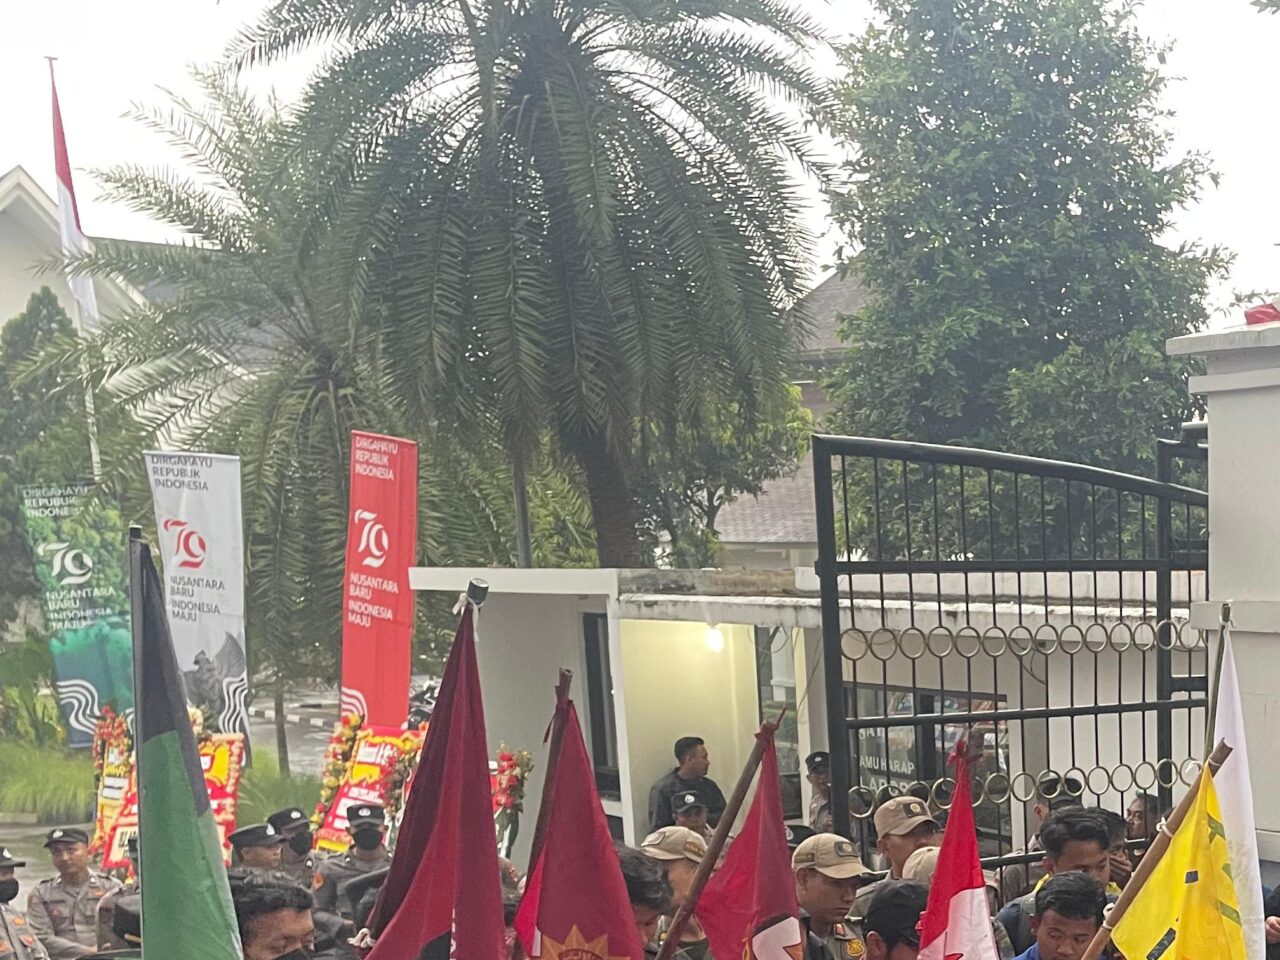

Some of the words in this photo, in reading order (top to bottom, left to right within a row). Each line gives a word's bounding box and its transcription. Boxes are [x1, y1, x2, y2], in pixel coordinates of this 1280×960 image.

[355, 436, 398, 454] DIRGAHAYU
[151, 455, 213, 468] DIRGAHAYU
[355, 450, 389, 466] REPUBLIK
[153, 468, 200, 479] REPUBLIK
[355, 463, 394, 480] INDONESIA
[23, 486, 88, 498] DIRGAHAYU
[154, 479, 209, 491] INDONESIA
[170, 576, 225, 590] NUSANTARA
[350, 572, 399, 593] NUSANTARA
[46, 586, 116, 601] NUSANTARA
[170, 586, 195, 598] BARU
[349, 584, 372, 600] BARU
[48, 599, 80, 610] BARU
[171, 599, 220, 614] INDONESIA
[348, 600, 393, 620] INDONESIA
[172, 610, 198, 622] MAJU
[348, 612, 371, 627] MAJU
[857, 755, 880, 769] AMU
